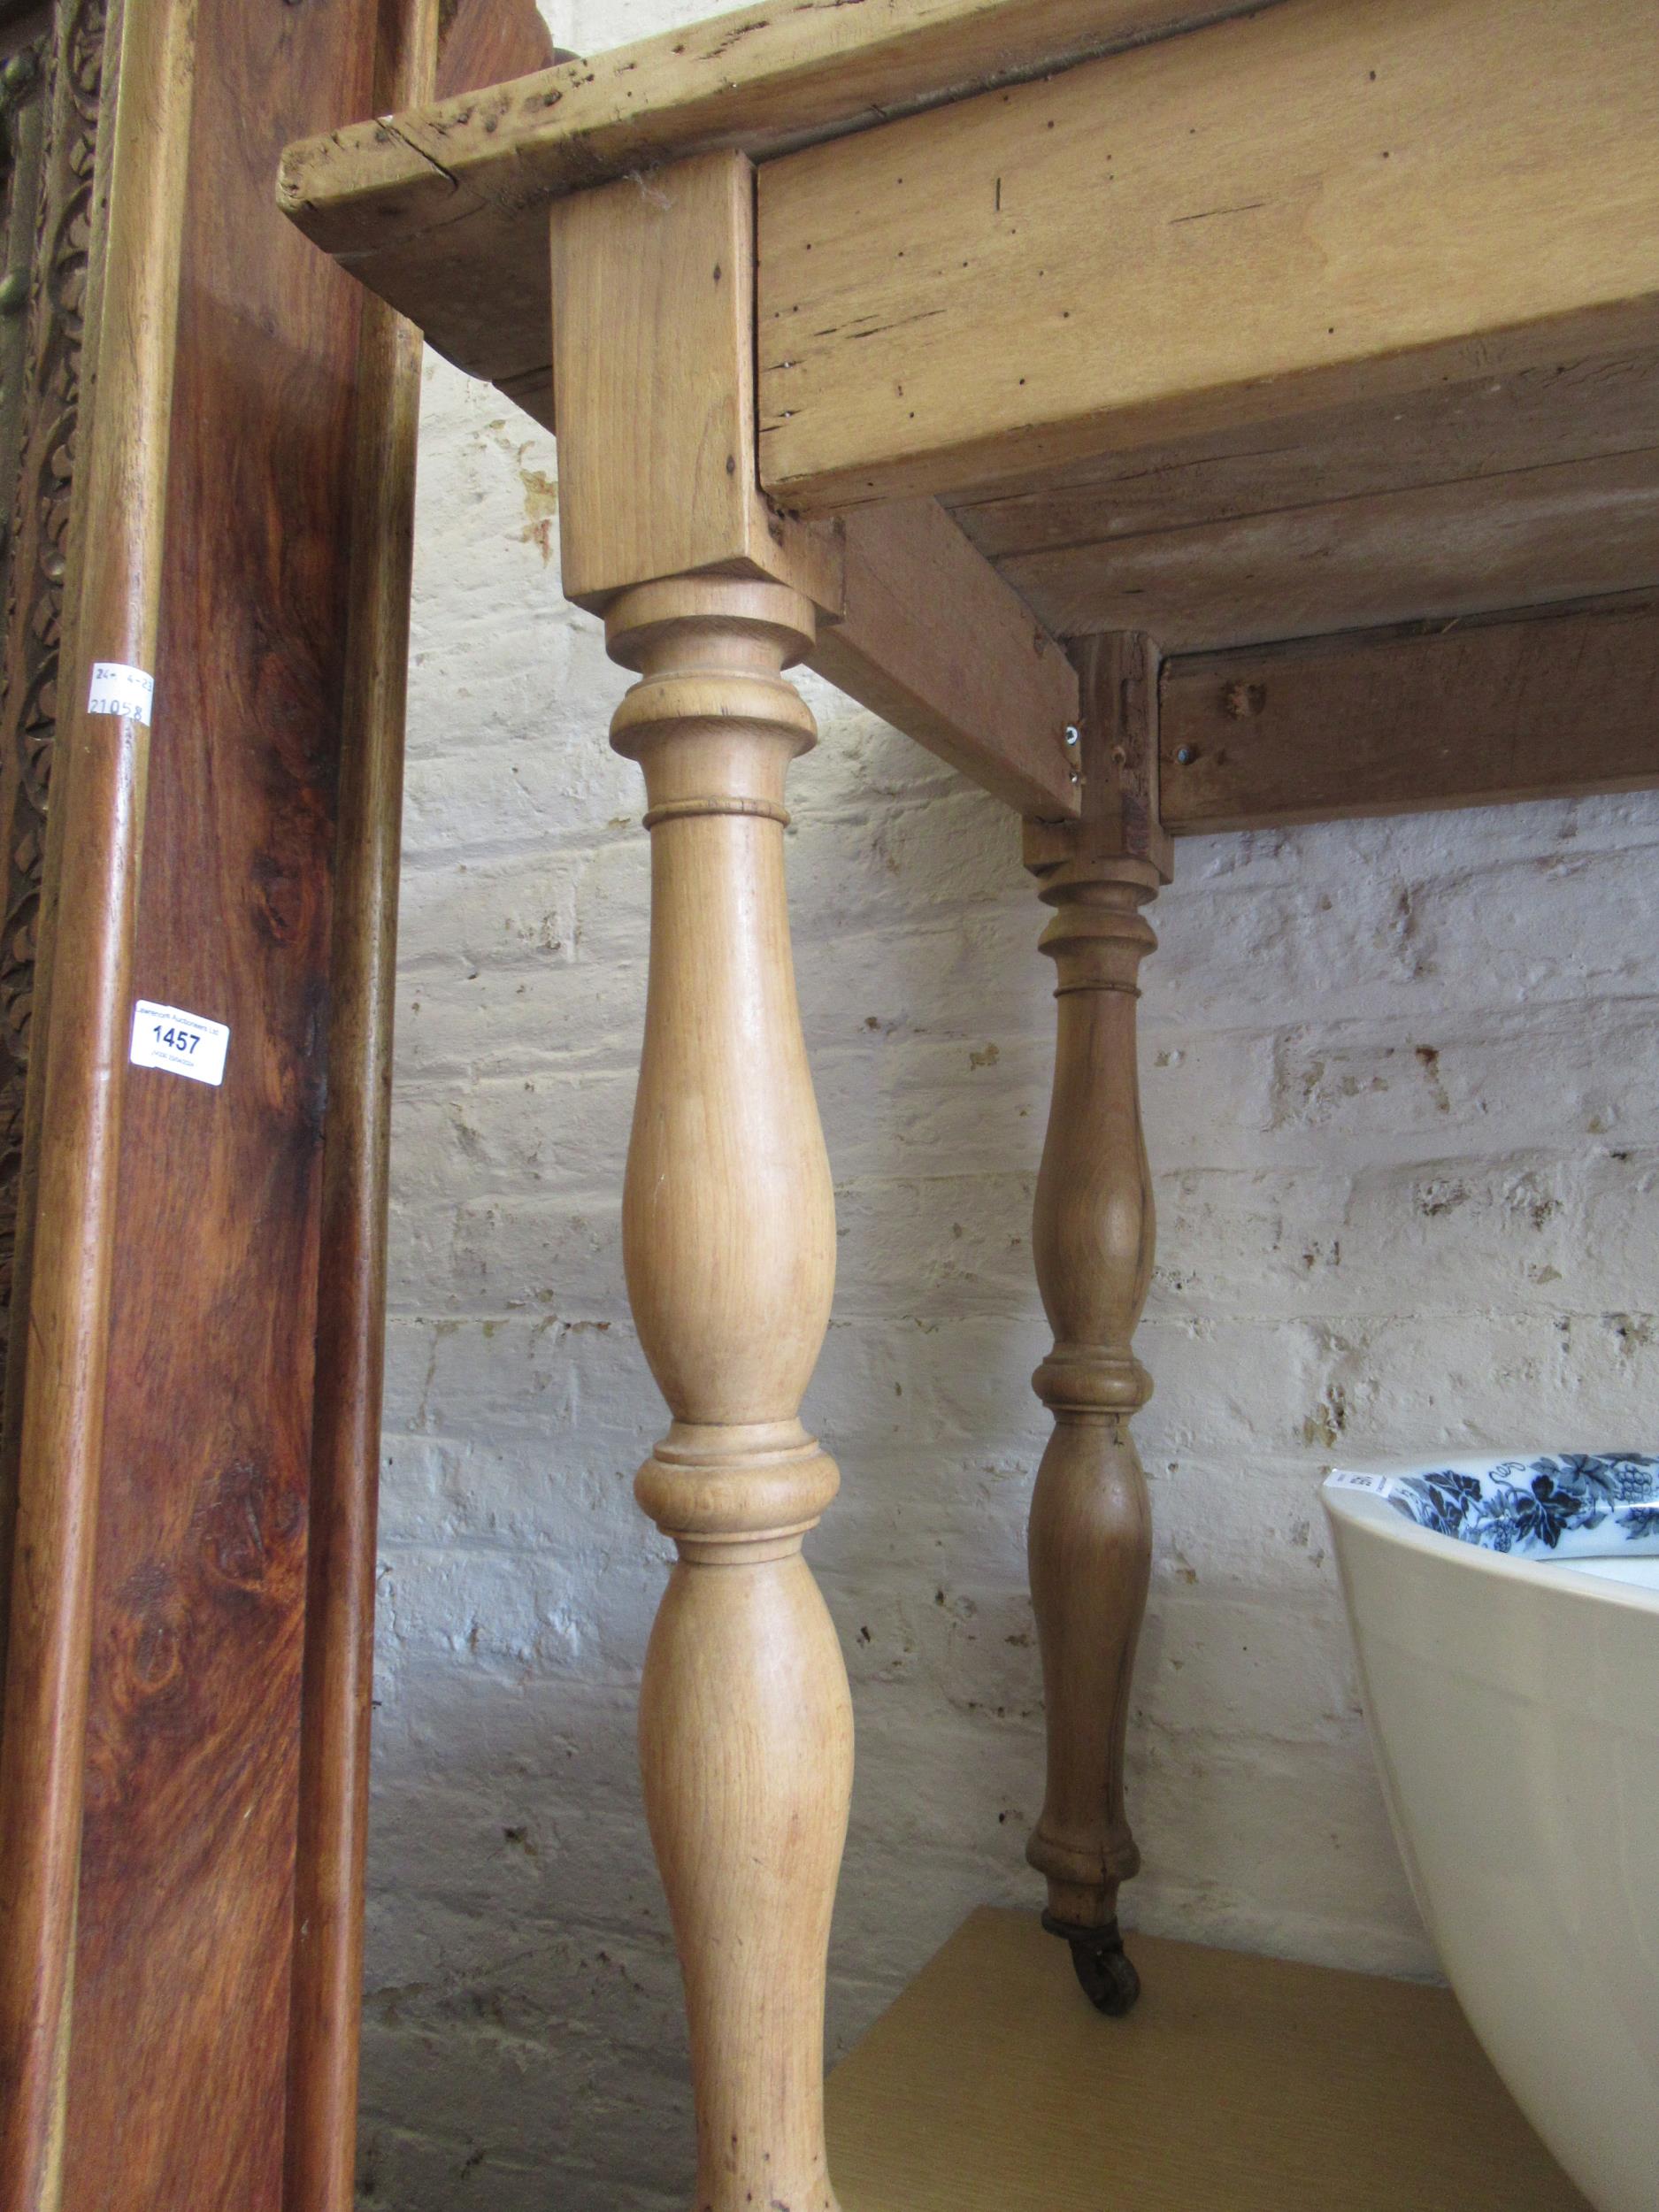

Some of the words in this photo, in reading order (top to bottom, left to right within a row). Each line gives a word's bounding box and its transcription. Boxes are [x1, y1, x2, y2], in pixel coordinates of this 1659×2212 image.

[89, 699, 142, 722] 21058
[173, 1015, 207, 1033] Auctioneers
[152, 1025, 201, 1055] 1457
